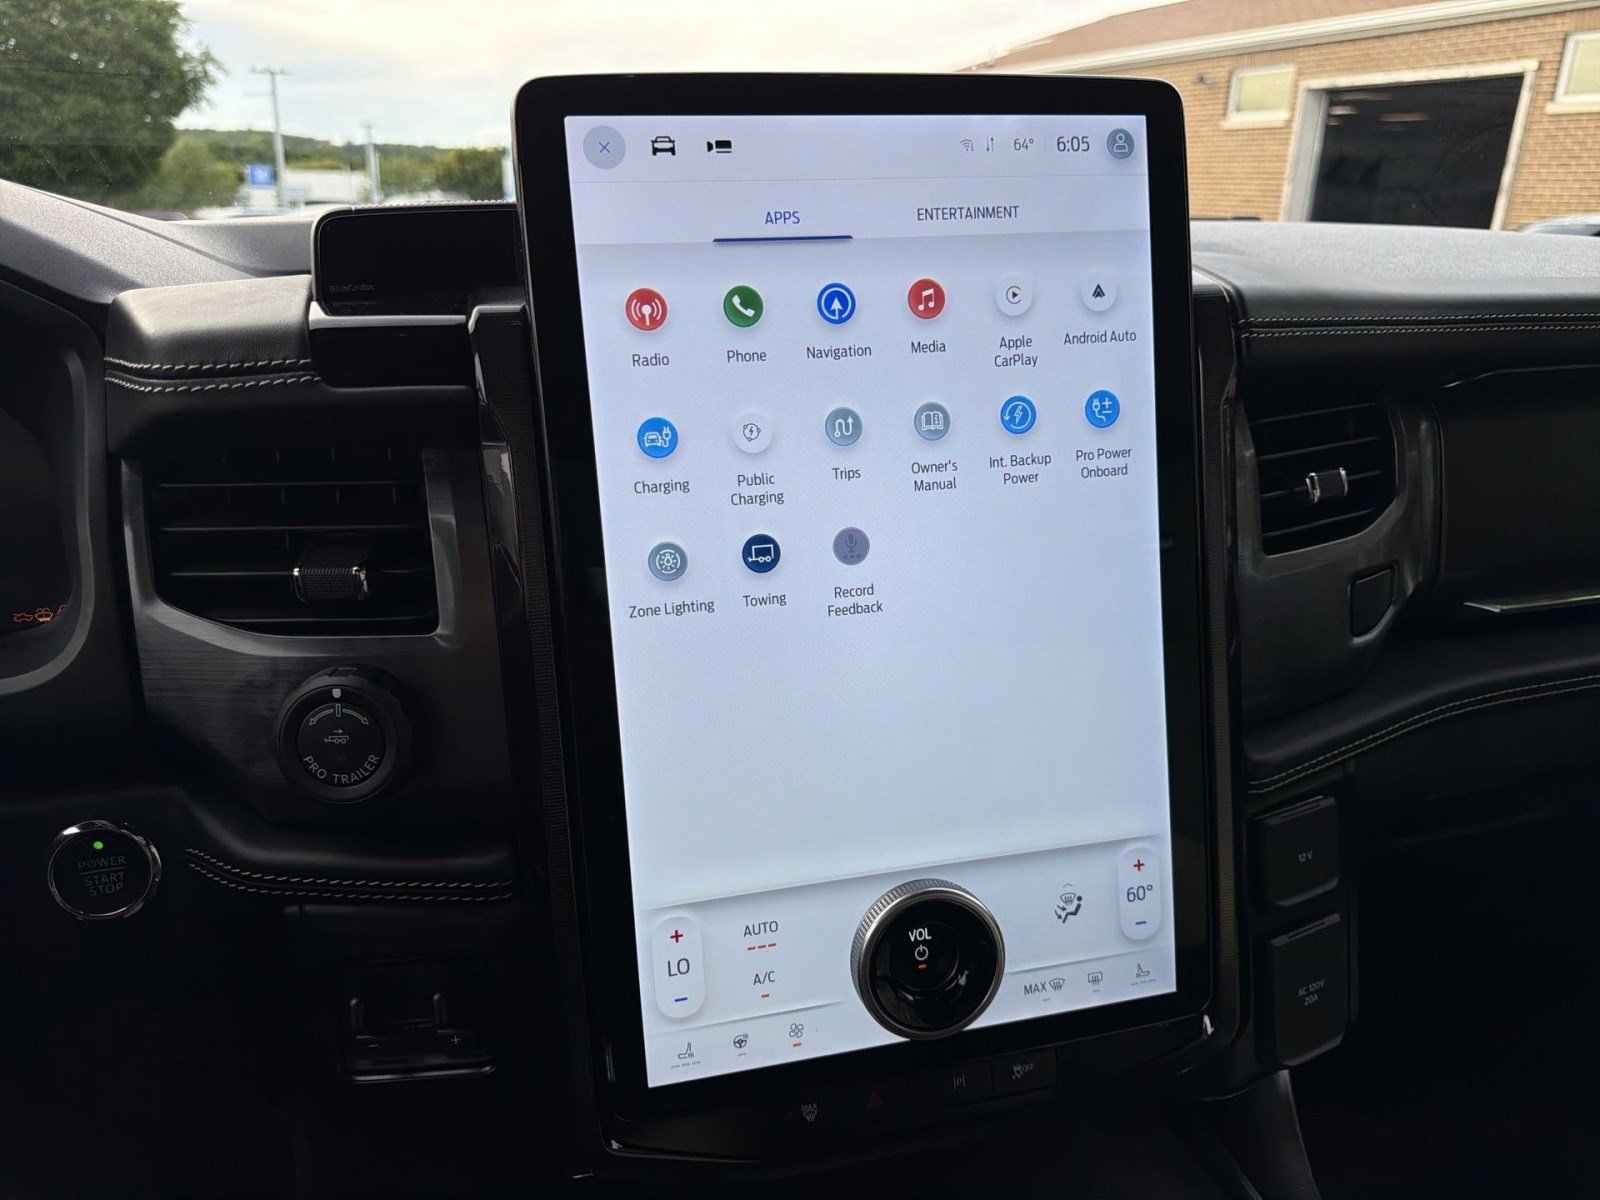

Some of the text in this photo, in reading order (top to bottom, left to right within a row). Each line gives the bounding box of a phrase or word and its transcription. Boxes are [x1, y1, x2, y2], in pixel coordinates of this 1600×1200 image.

[1056, 135, 1090, 152] 6:05
[764, 210, 801, 225] APPS
[916, 205, 1019, 221] ENTERTAINMENT
[999, 335, 1033, 350] Apple
[1063, 329, 1137, 345] Android Auto
[806, 344, 872, 361] Navigation
[910, 339, 946, 354] Media
[631, 353, 670, 367] Radio
[726, 349, 767, 363] Phone
[994, 353, 1038, 368] CarPlay
[989, 453, 1052, 468] Int. Backup
[1075, 447, 1132, 462] Pro Power
[831, 466, 861, 481] Trips
[911, 459, 958, 474] Owner's
[1080, 463, 1129, 479] Onboard
[736, 473, 775, 487] Public
[913, 477, 957, 492] Manual
[1003, 472, 1039, 485] Power
[633, 479, 690, 495] Charging
[730, 491, 785, 506] Charging
[834, 583, 875, 599] Record
[742, 593, 787, 608] Towing
[628, 600, 715, 619] Zone Lighting
[827, 601, 884, 617] Feedback
[302, 754, 380, 784] PRO TRAILER
[77, 855, 127, 870] POWER
[84, 871, 125, 887] START
[89, 882, 124, 897] STOP
[743, 920, 779, 938] AUTO
[909, 927, 932, 942] VOL
[667, 957, 690, 977] LO
[753, 970, 776, 986] A/C
[1023, 980, 1048, 996] MAX
[1298, 986, 1307, 997] AC
